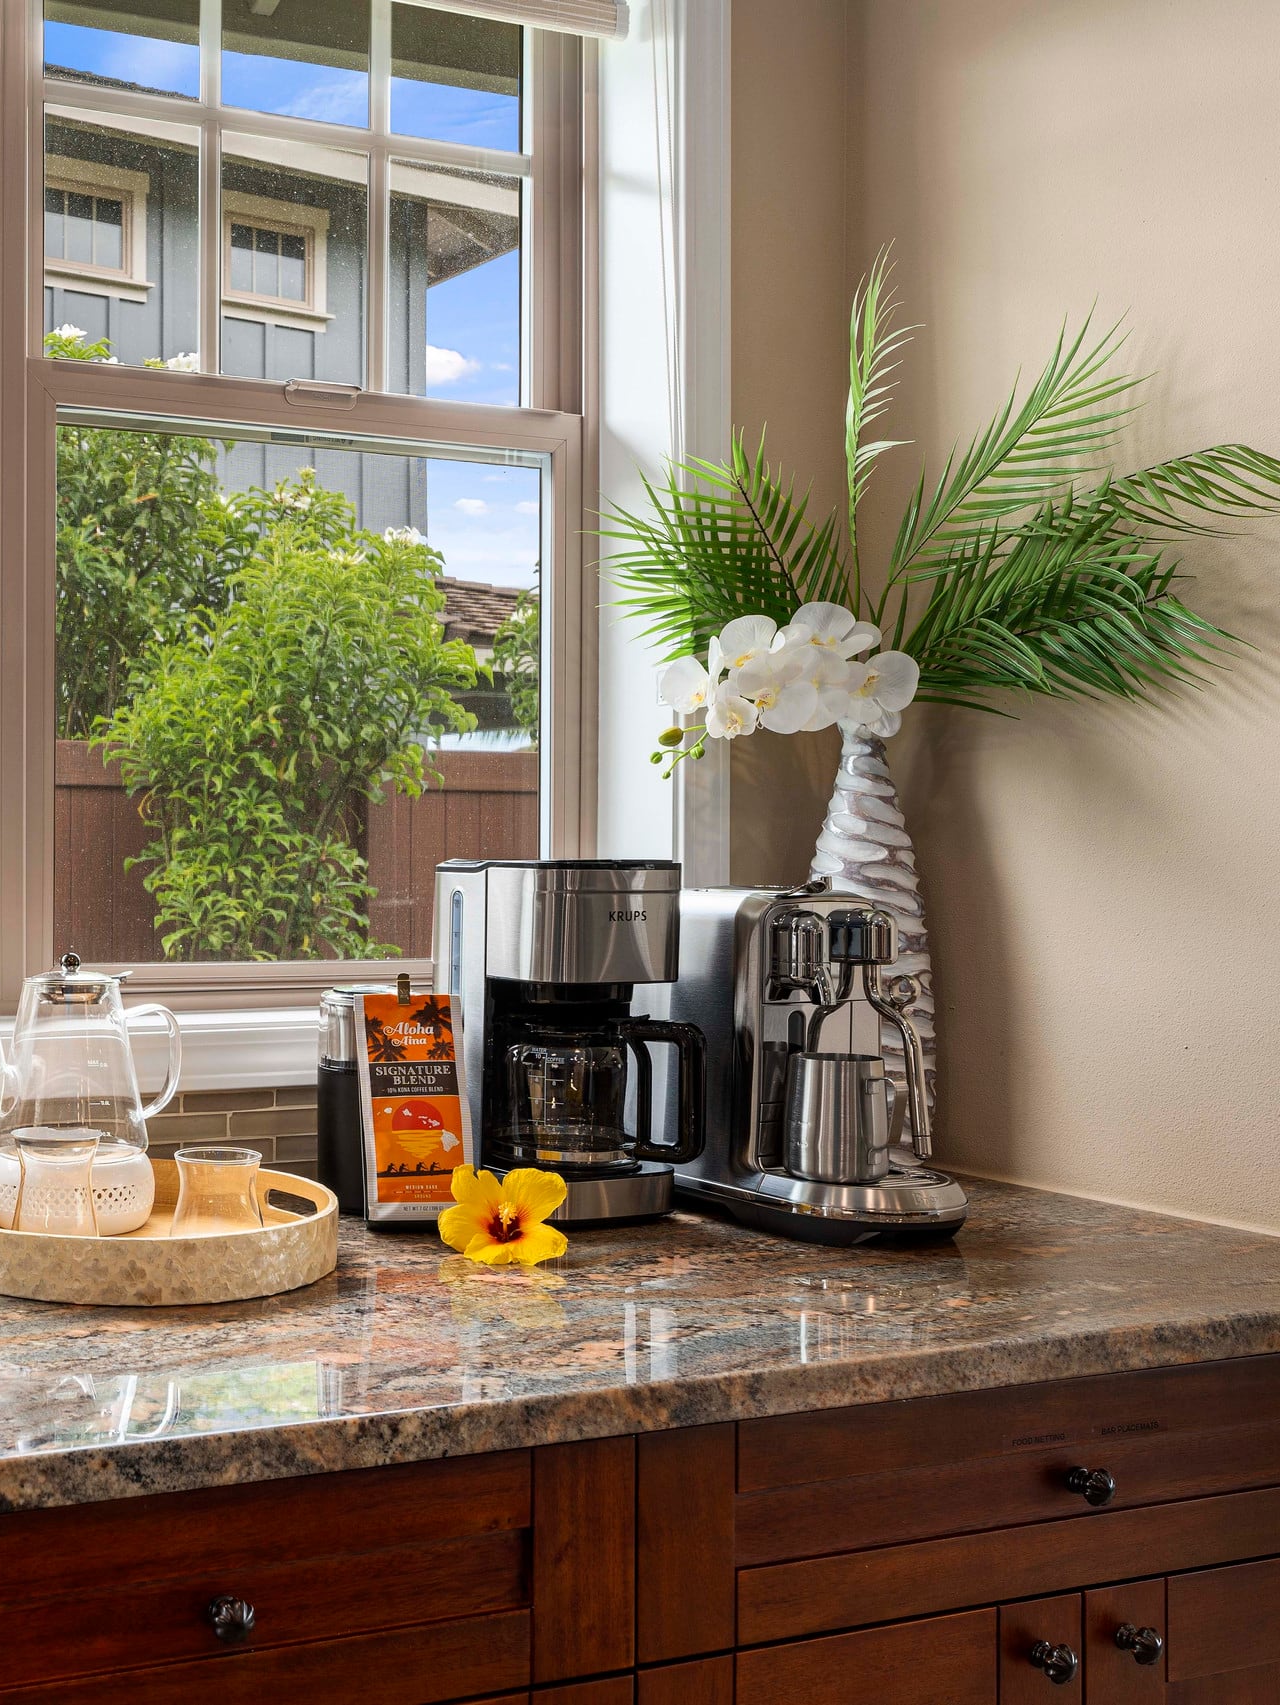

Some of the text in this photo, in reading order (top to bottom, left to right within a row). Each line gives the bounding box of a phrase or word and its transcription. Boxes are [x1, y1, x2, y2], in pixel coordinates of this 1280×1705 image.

[608, 910, 647, 922] KRUPS
[383, 1022, 435, 1036] Aloha
[391, 1036, 427, 1047] Aina
[375, 1065, 451, 1076] SIGNATURE
[393, 1075, 437, 1085] BLEND
